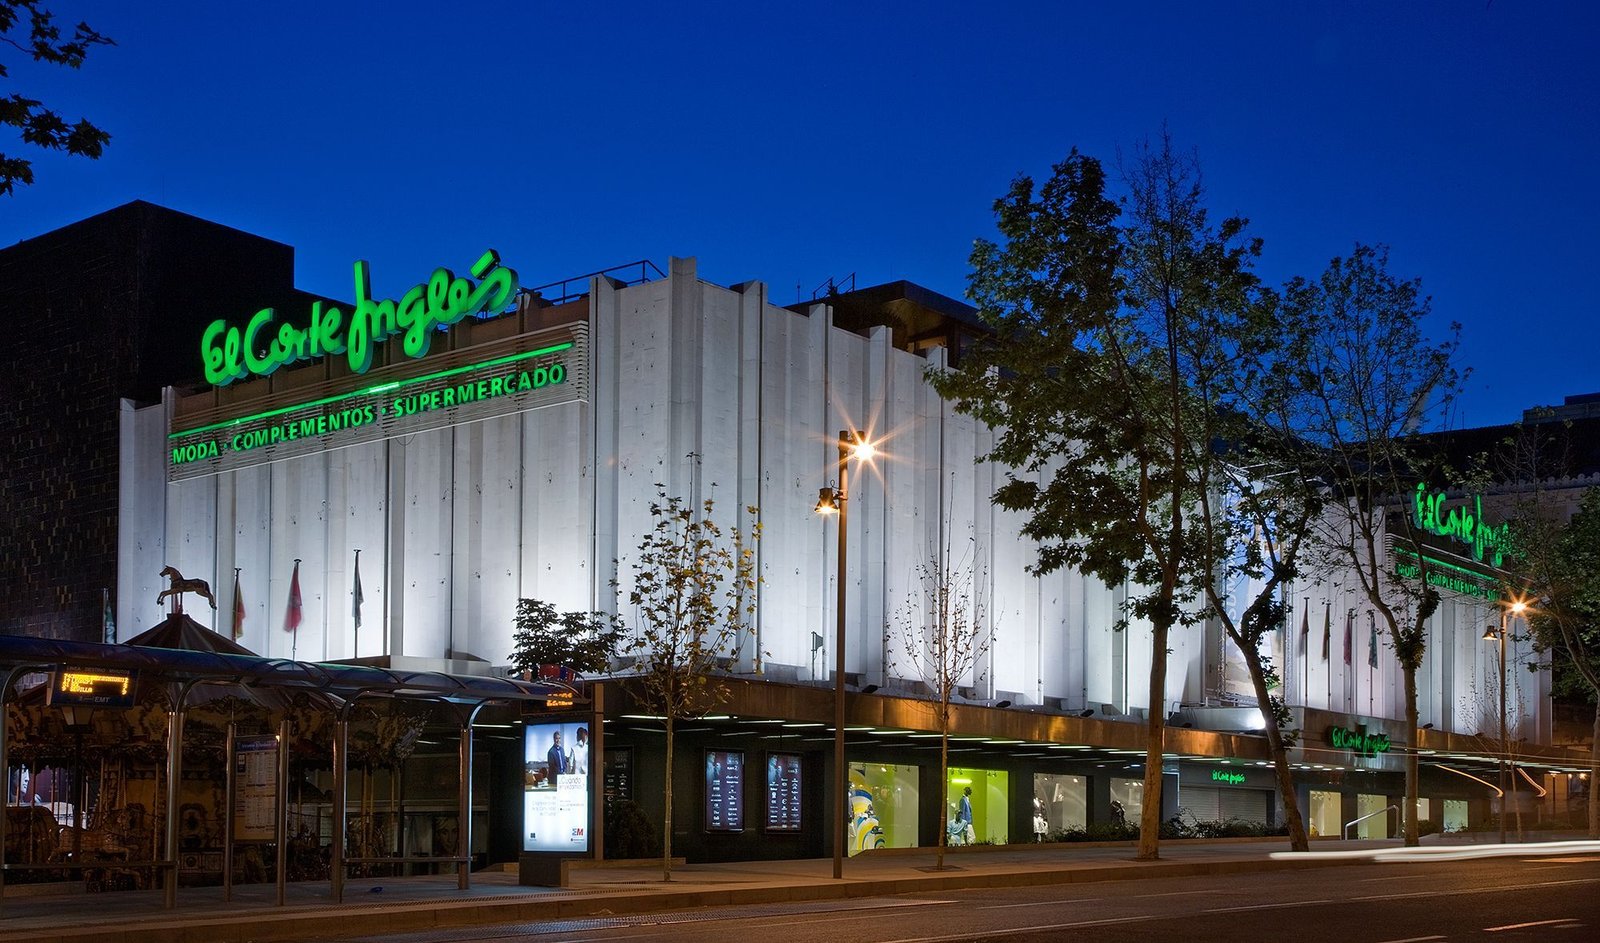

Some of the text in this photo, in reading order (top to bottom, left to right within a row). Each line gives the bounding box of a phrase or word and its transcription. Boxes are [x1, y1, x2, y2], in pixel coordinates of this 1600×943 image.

[202, 249, 518, 385] El Corte Inglés
[172, 364, 566, 464] MODA COMPLEMENTOS SUPERMERCADO
[1435, 493, 1474, 543] Corte
[1333, 727, 1341, 747] El
[1342, 728, 1362, 749] Corte
